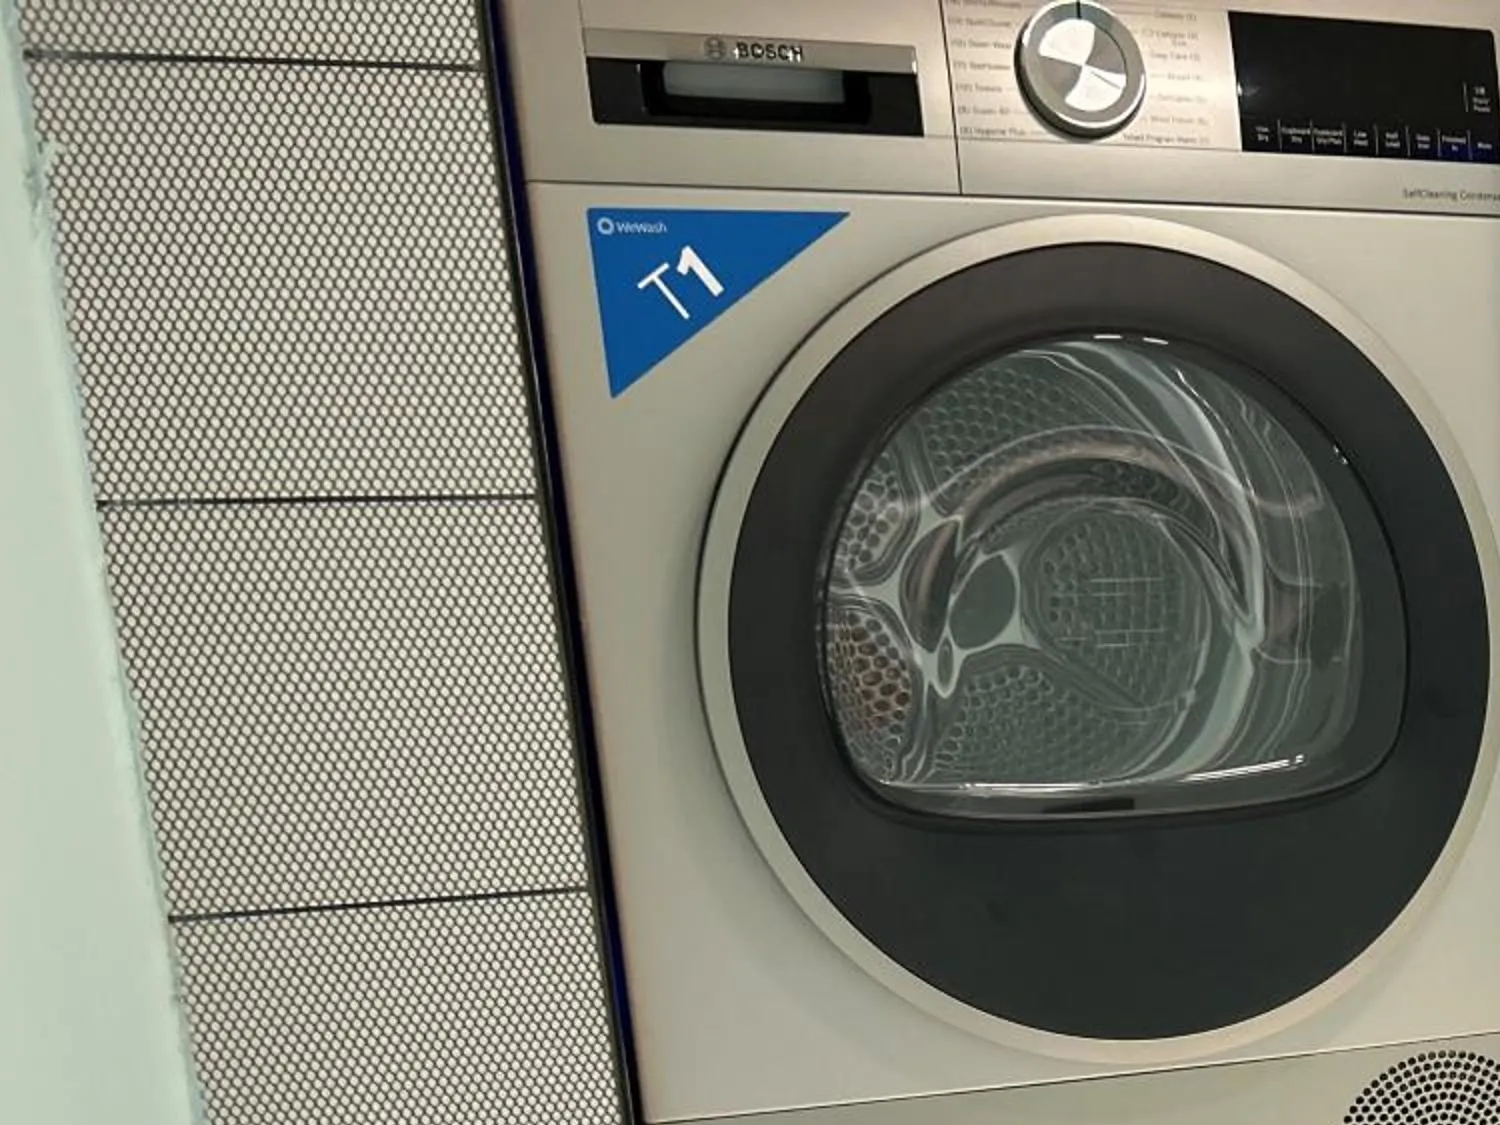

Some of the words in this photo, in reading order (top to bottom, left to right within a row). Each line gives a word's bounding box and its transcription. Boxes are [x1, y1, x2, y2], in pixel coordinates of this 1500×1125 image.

[735, 41, 804, 63] BOSCH
[615, 221, 667, 234] WeWash
[637, 245, 725, 320] T1
